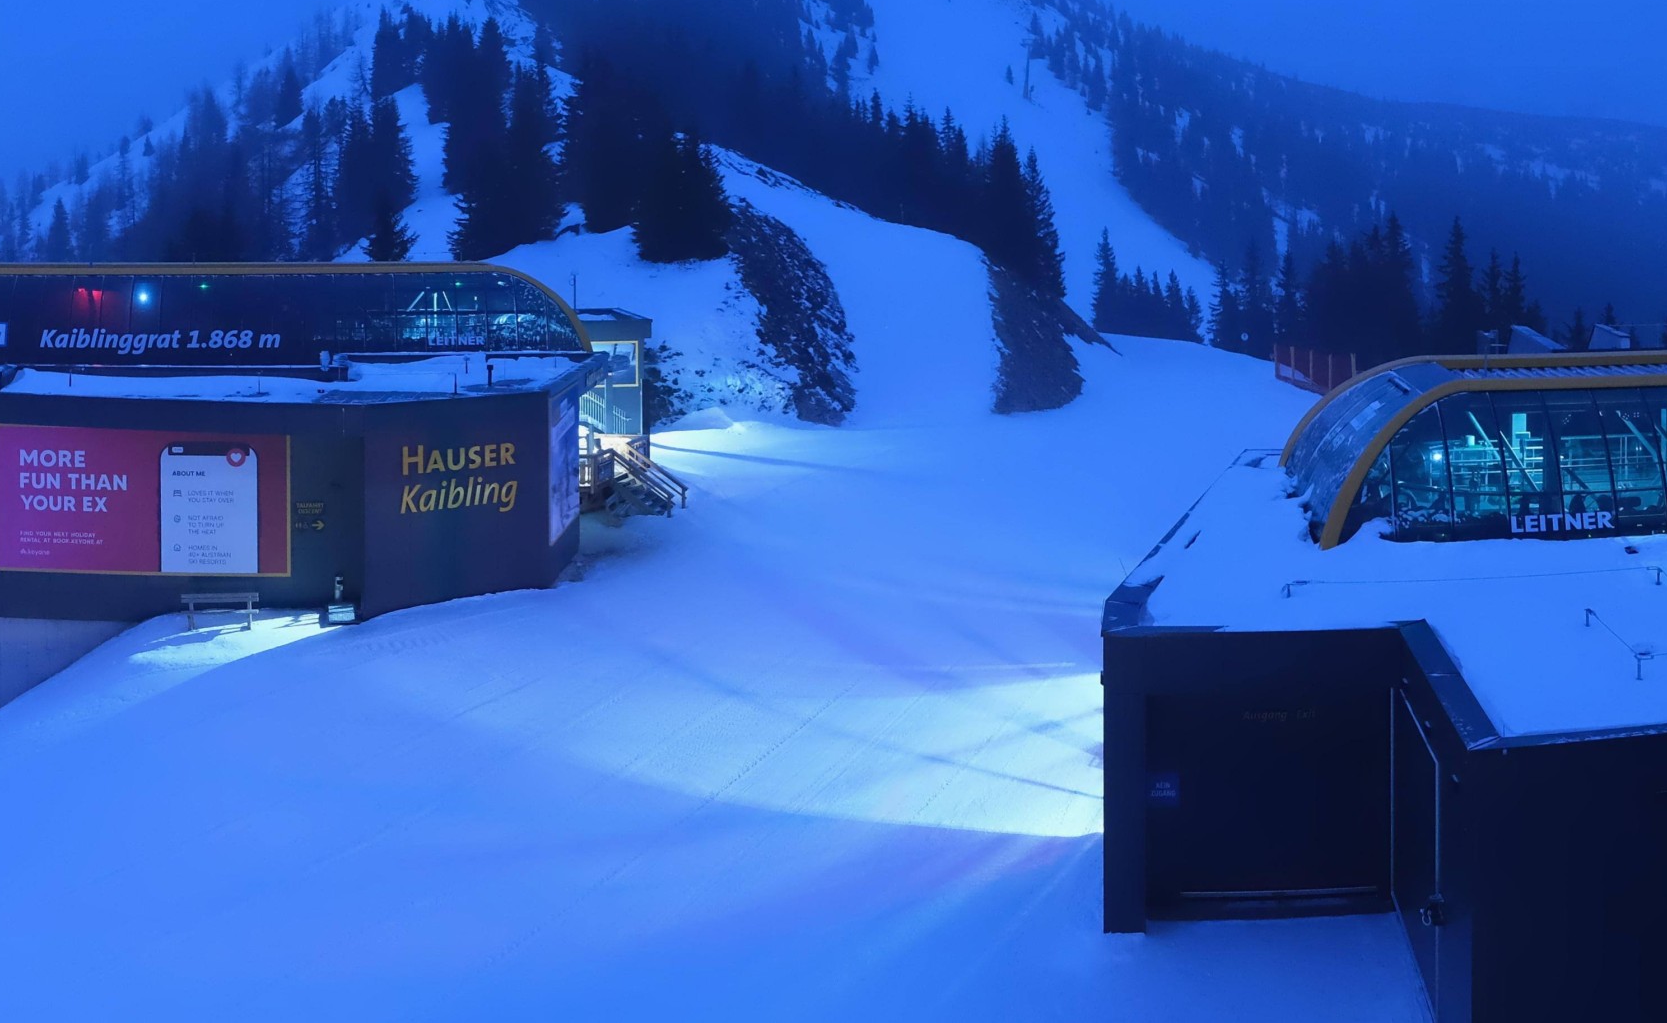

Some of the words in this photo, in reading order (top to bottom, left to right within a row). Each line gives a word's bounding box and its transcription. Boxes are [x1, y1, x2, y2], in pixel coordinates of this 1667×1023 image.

[39, 328, 181, 355] Kaiblinggrat
[186, 329, 252, 348] 1.868
[258, 333, 281, 348] m
[428, 336, 485, 346] LEITNER
[20, 449, 86, 468] MORE
[402, 442, 516, 476] HAUSER
[20, 472, 60, 490] FUN
[68, 473, 128, 491] THAN
[20, 494, 76, 512] YOUR
[82, 496, 108, 512] EX
[400, 476, 518, 514] Kaibling
[1510, 511, 1615, 534] LEITNER
